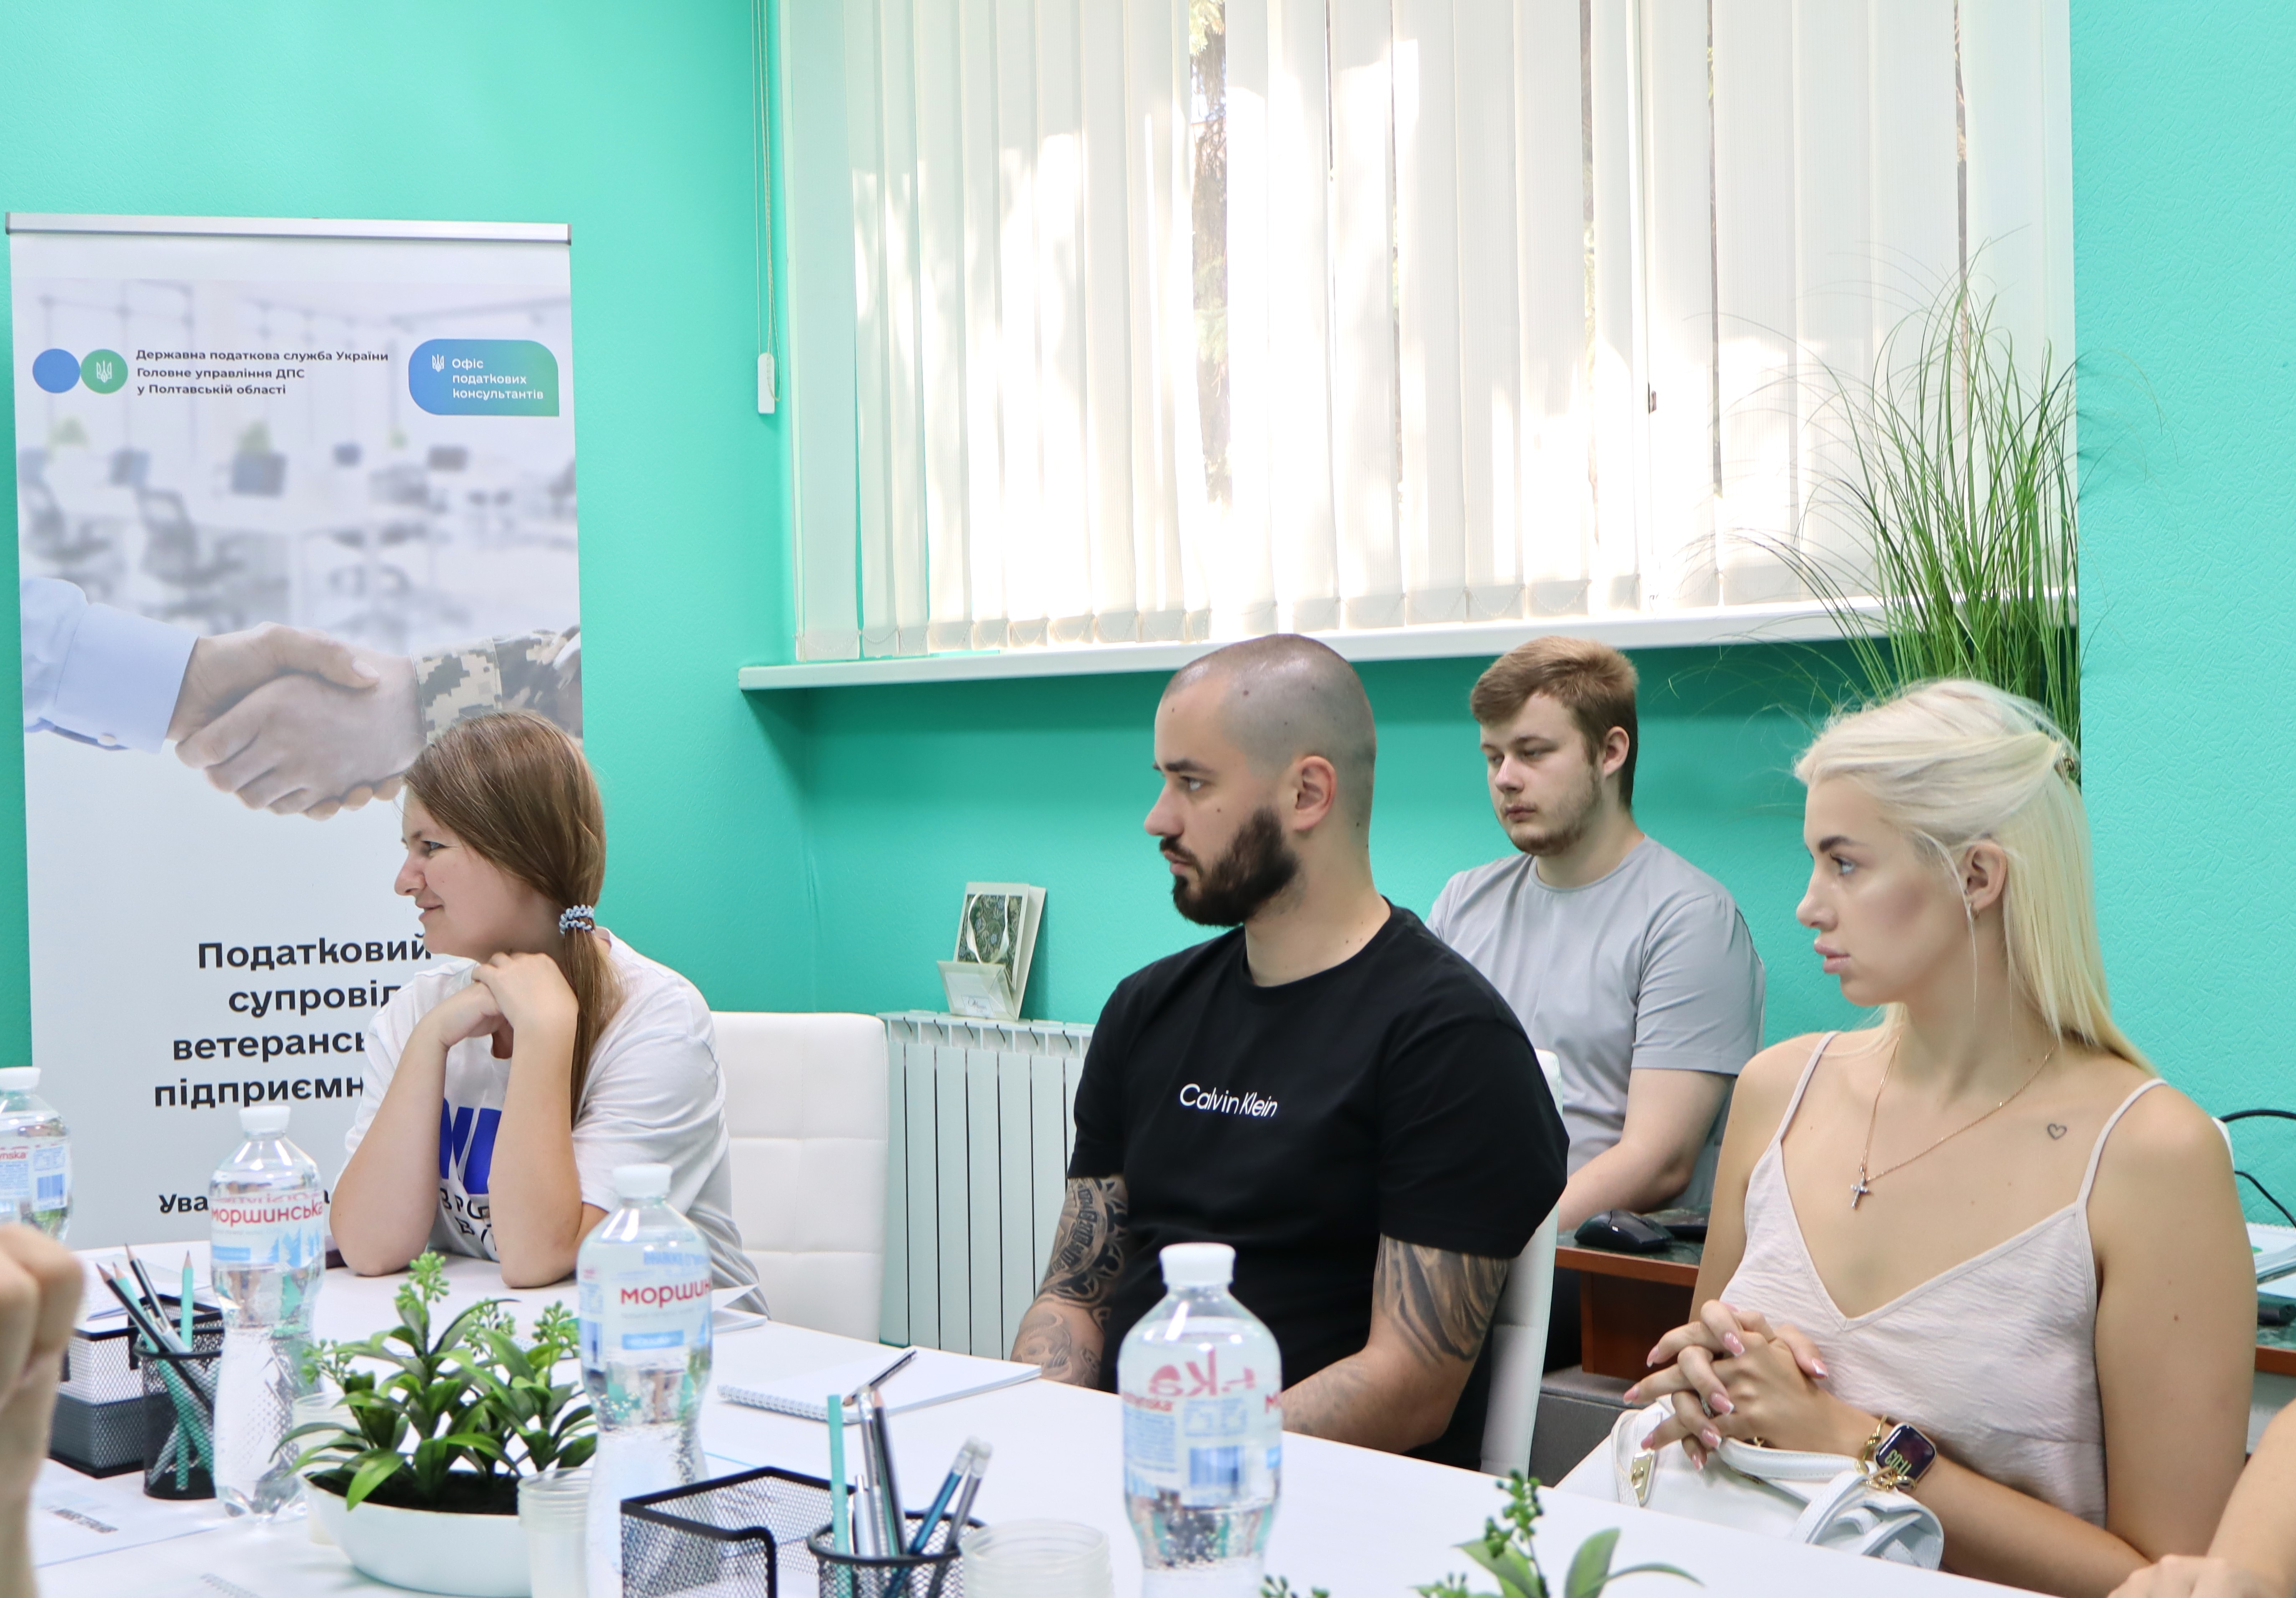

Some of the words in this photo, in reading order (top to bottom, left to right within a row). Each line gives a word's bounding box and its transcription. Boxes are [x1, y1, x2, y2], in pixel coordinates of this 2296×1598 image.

[136, 350, 205, 361] Державна
[210, 352, 280, 361] податкова
[284, 351, 332, 363] служба
[336, 351, 388, 362] України
[452, 358, 484, 370] Офіс
[137, 368, 191, 378] Головне
[195, 368, 272, 380] управління
[276, 369, 305, 380] ДПС
[452, 373, 527, 385] податкових
[137, 386, 145, 396] у
[149, 384, 233, 394] Полтавській
[236, 384, 286, 395] області
[453, 388, 543, 401] консультантів
[198, 933, 432, 971] Податковий
[1180, 1083, 1239, 1115] Calvin
[1239, 1092, 1278, 1118] Klein
